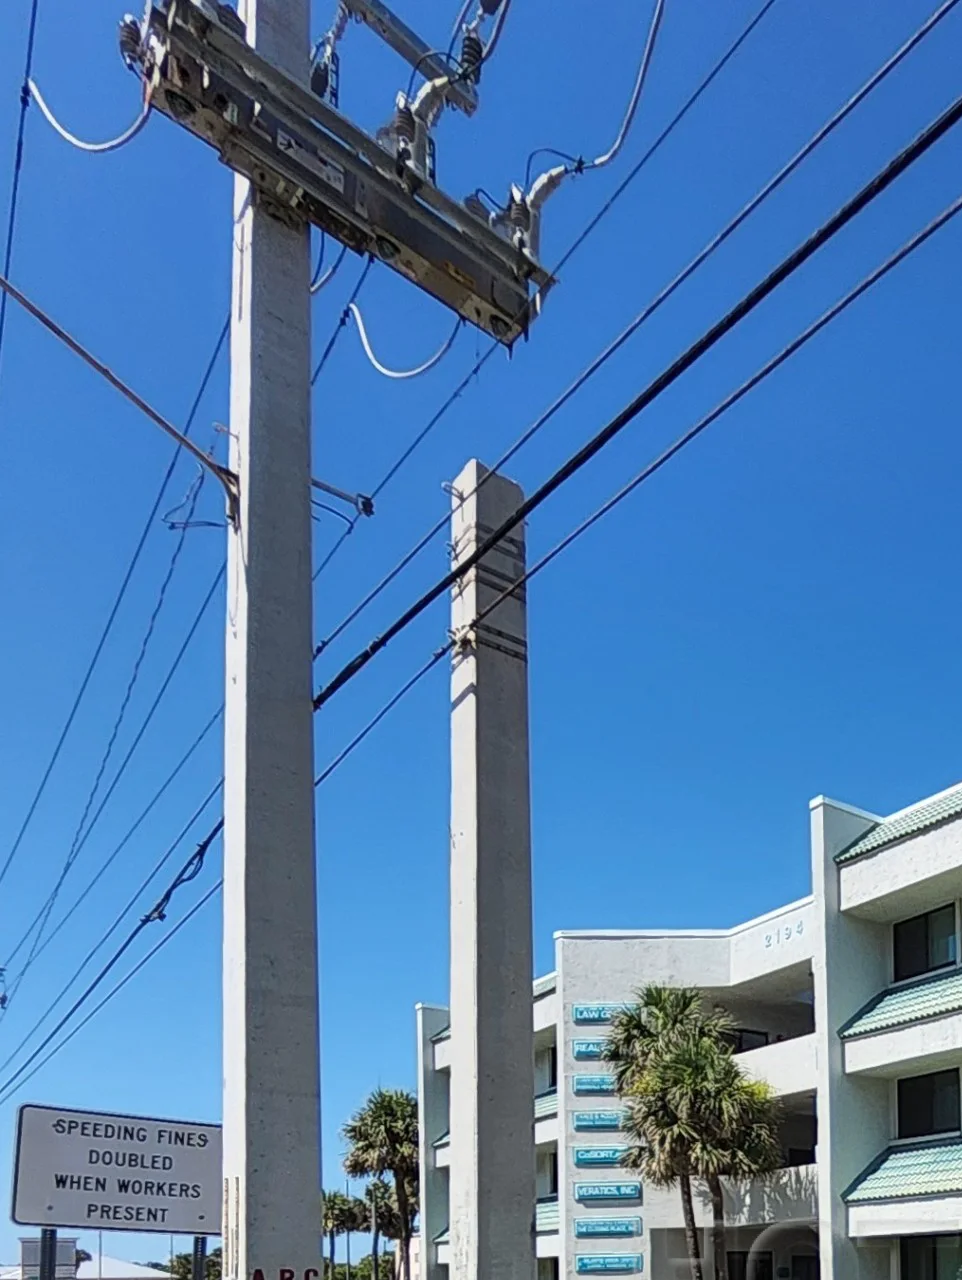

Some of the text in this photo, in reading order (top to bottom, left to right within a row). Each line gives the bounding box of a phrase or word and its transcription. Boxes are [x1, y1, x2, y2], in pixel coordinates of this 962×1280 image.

[764, 919, 804, 949] 2194
[576, 1009, 599, 1019] LAW
[53, 1118, 208, 1148] SPEEDING FINES
[88, 1149, 173, 1170] DOUBLED
[54, 1173, 201, 1199] WHEN WORKERS
[87, 1203, 168, 1223] PRESENT
